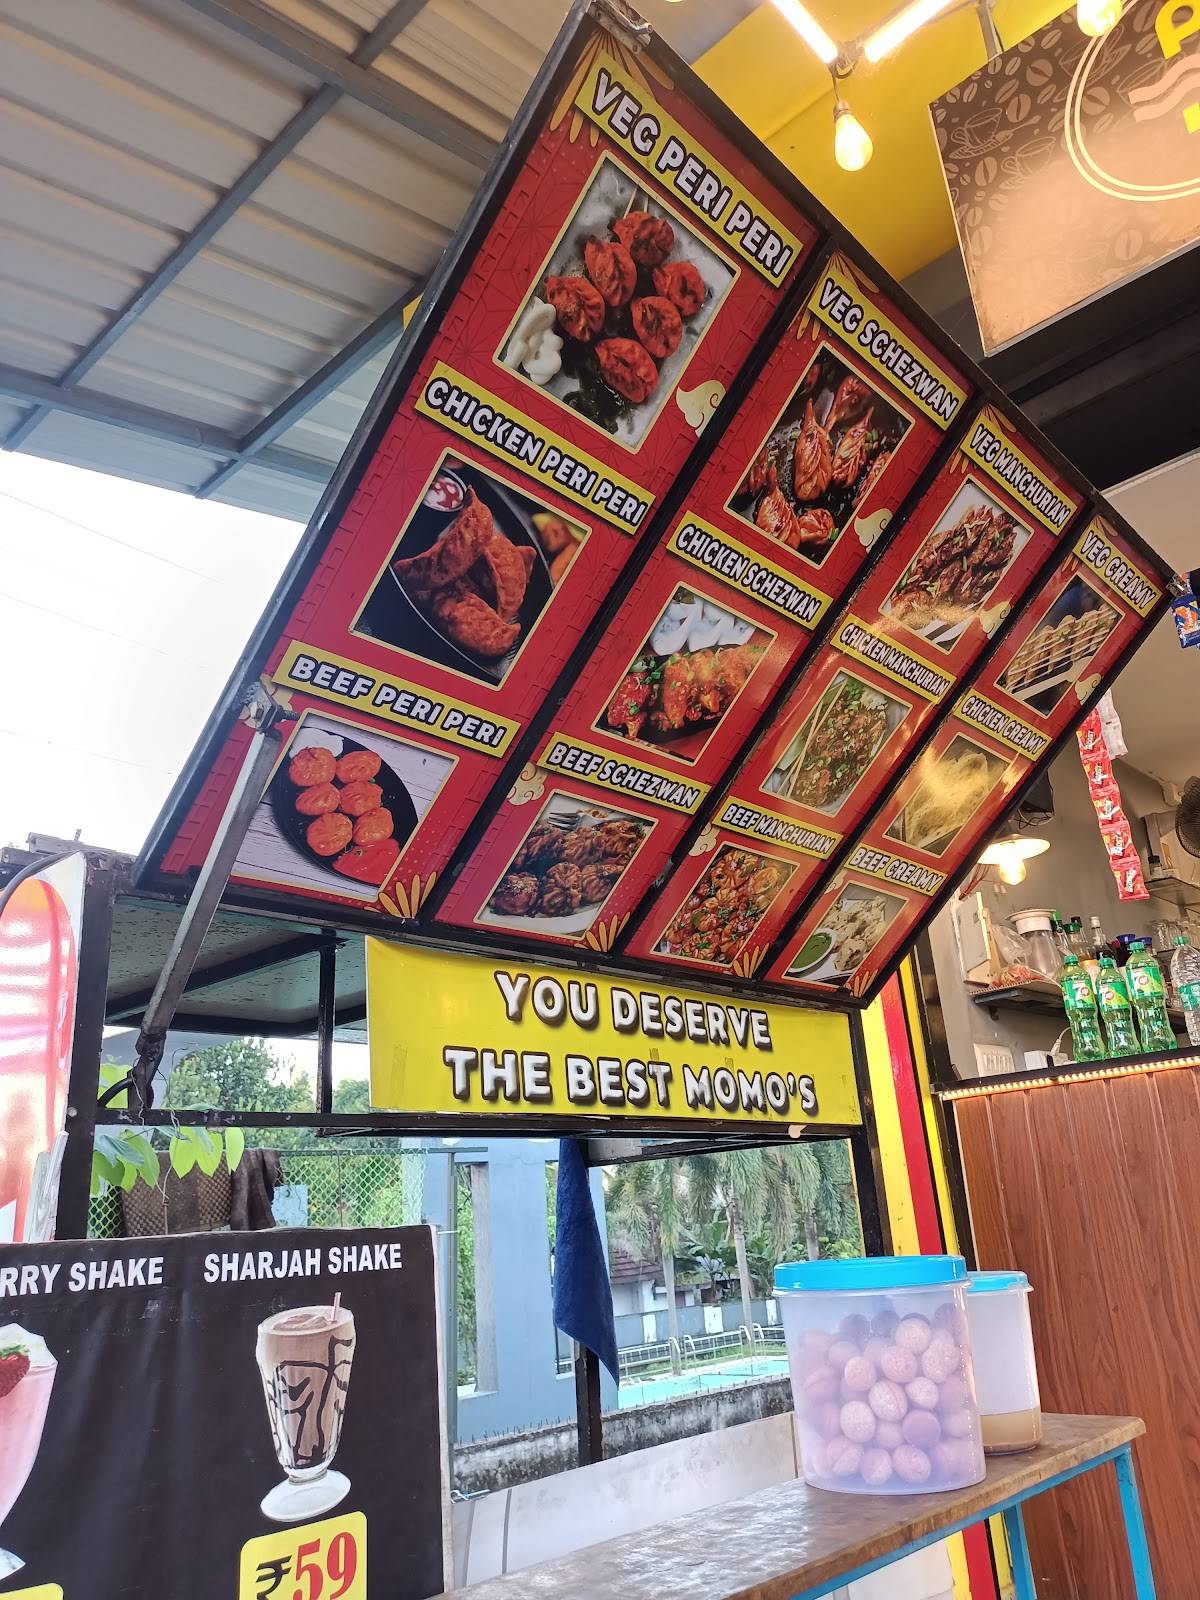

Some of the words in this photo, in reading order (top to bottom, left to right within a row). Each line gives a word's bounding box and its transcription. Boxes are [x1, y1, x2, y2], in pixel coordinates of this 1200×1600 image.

[592, 68, 660, 156] VEG
[655, 136, 732, 221] PERI
[724, 201, 793, 278] PERI
[819, 277, 864, 333] VEG
[858, 320, 959, 421] SCHEZWAN
[425, 377, 545, 466] CHICKEN
[539, 446, 600, 496] PERI
[594, 480, 648, 528] PERI
[970, 423, 1001, 463] VEG
[993, 448, 1071, 528] MANCHURIAN
[676, 523, 750, 582] CHICKEN
[741, 563, 822, 622] SCHEZWAN
[1081, 530, 1111, 568] VEG
[1104, 557, 1156, 609] CREAMY
[840, 623, 890, 664] CHICKEN
[883, 648, 950, 696] MANCHURIAN
[288, 654, 374, 699] BEEF
[372, 684, 443, 725] PERI
[441, 709, 507, 747] PERI
[962, 696, 1010, 733] CHICKEN
[1002, 720, 1047, 754] CREAMY
[547, 742, 604, 776] BEEF
[598, 760, 700, 808] SCHEZWAN
[721, 804, 761, 830] BEEF
[754, 816, 836, 854] MANCHURIAN
[849, 847, 891, 873] BEEF
[884, 859, 943, 892] CREAMY
[494, 970, 599, 1027] YOU
[609, 987, 773, 1051] DESERVE
[442, 1045, 553, 1102] THE
[565, 1054, 673, 1107] BEST
[682, 1063, 818, 1115] MOMO'S
[68, 1257, 164, 1292] SHAKE
[203, 1248, 321, 1283] SHARJAH
[327, 1243, 402, 1274] SHAKE
